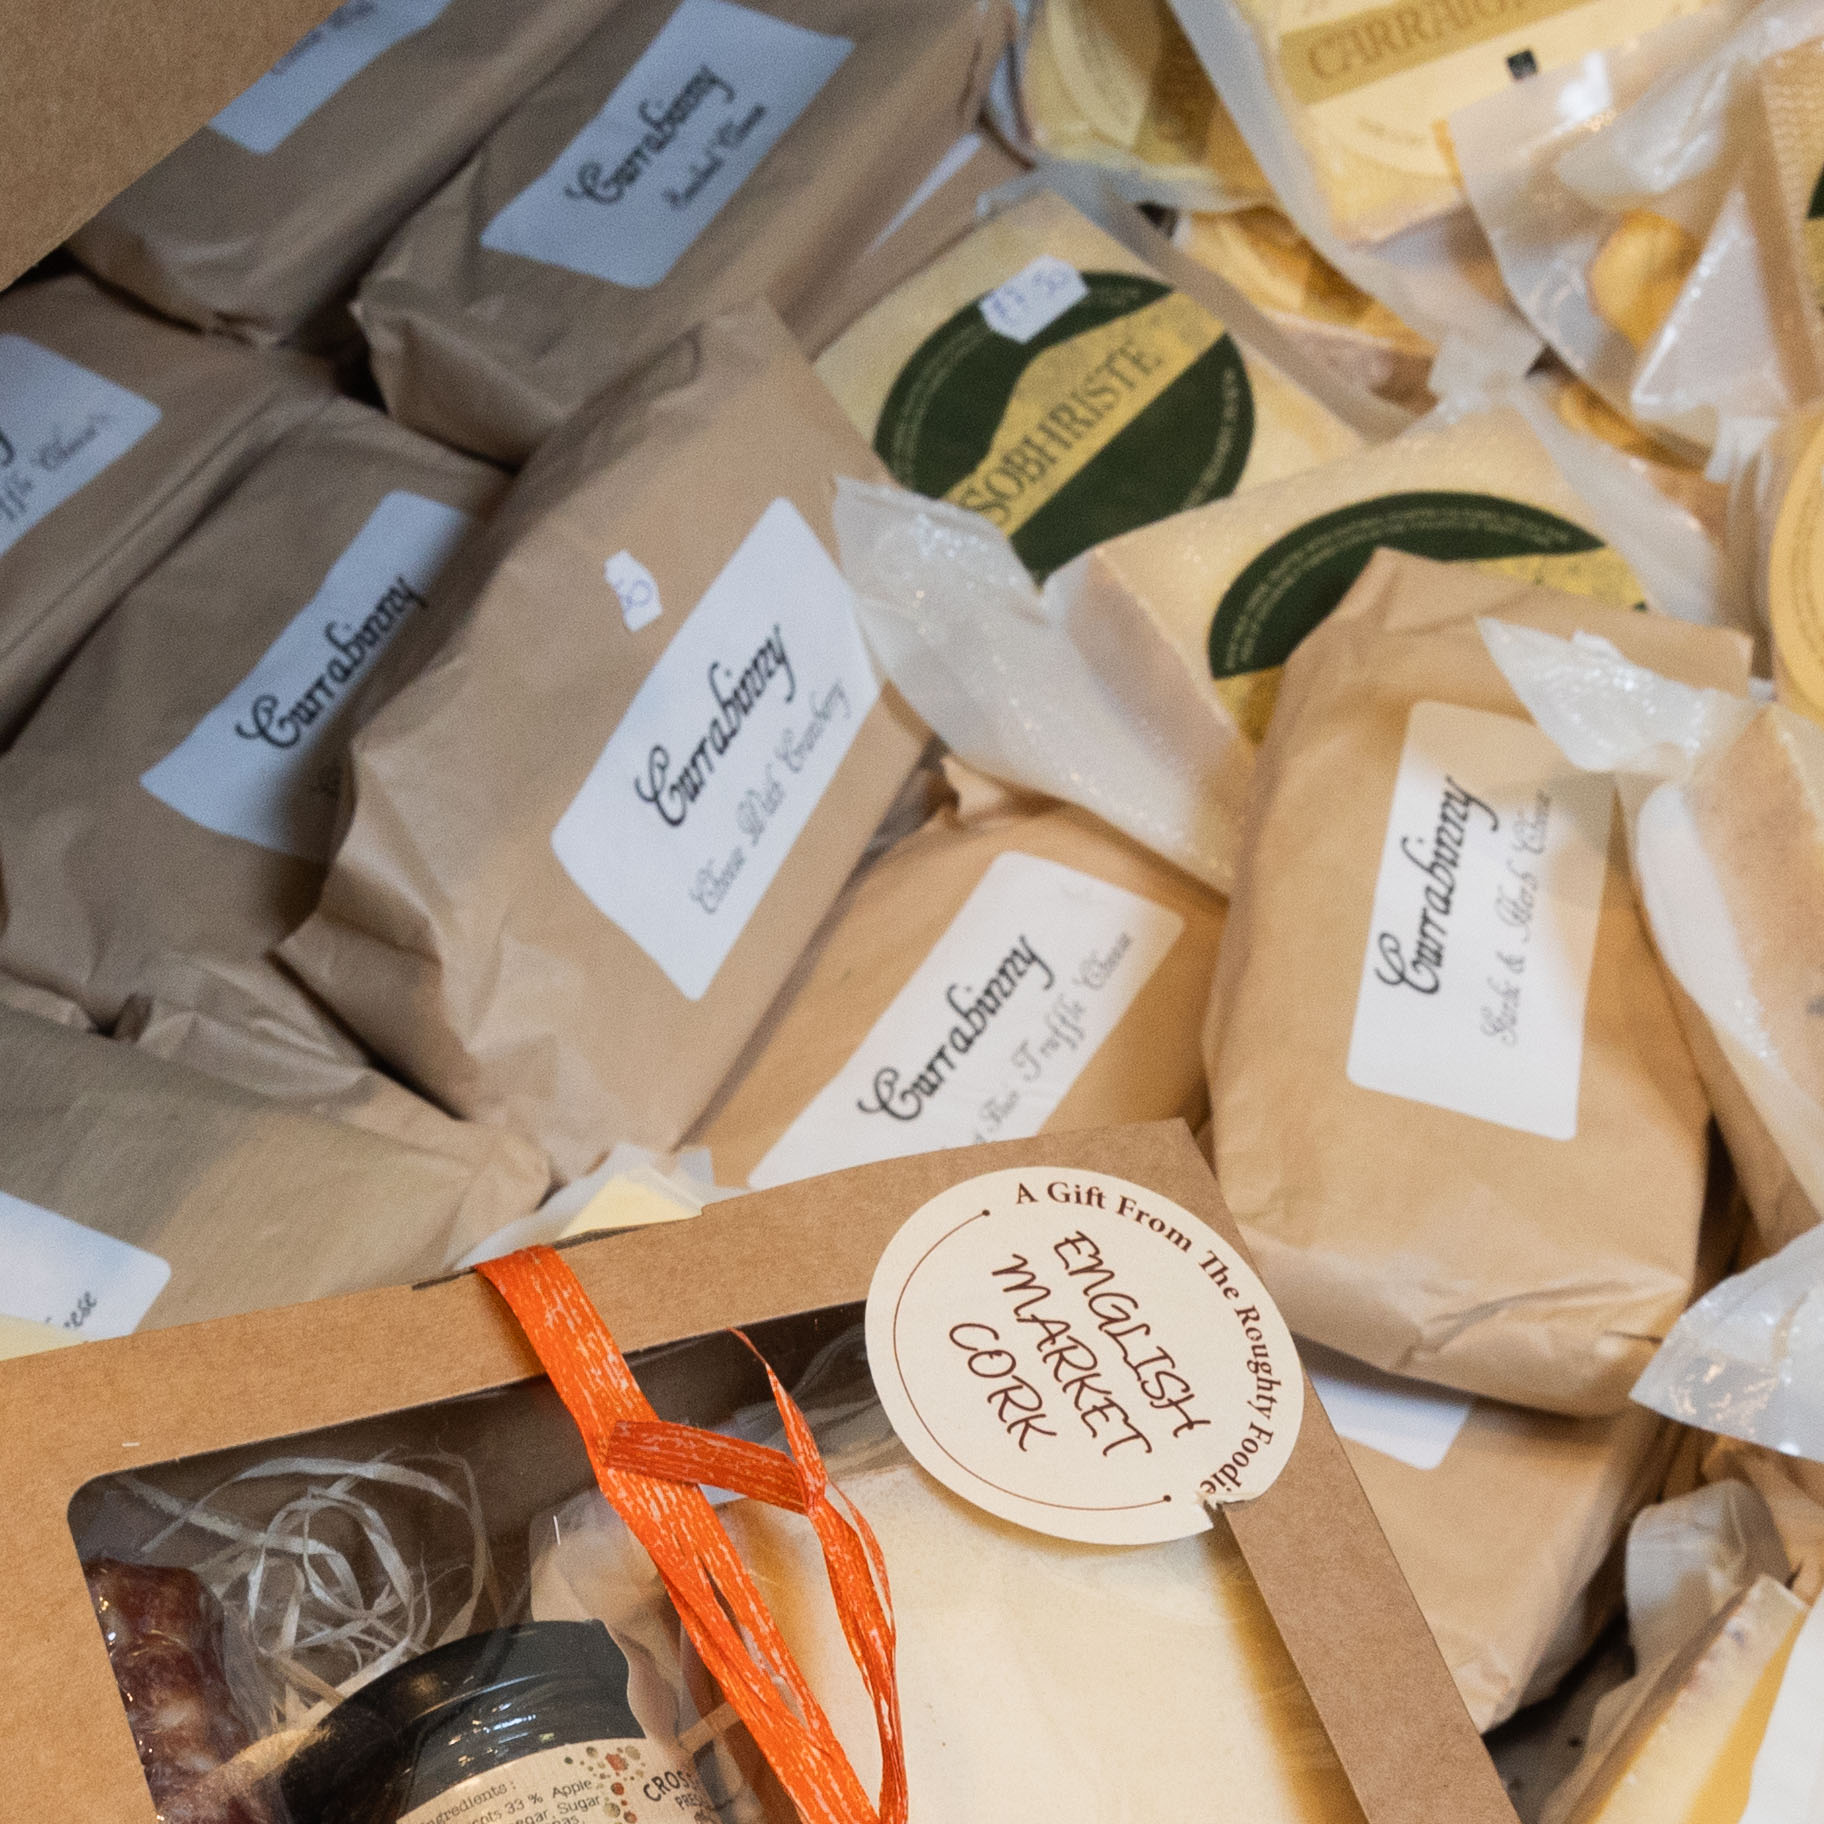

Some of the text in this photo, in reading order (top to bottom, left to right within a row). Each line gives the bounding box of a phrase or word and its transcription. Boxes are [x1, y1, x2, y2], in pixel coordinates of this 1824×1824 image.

[564, 64, 739, 208] Currabinny
[962, 335, 1164, 531] SOBHRISTE
[236, 576, 431, 751] Currabinny
[634, 623, 798, 831] Currabinny
[1377, 774, 1501, 999] Currabinny
[858, 934, 1055, 1124] Currabinny
[949, 1321, 1058, 1453] CORK
[991, 1253, 1153, 1457] MARKET
[1015, 1180, 1282, 1497] A Gift From The Roughty Foodie
[1053, 1230, 1212, 1439] ENGLISH
[507, 1798, 527, 1816] 33
[529, 1792, 544, 1807] %
[551, 1777, 593, 1800] Apple
[556, 1794, 602, 1817] Sugar
